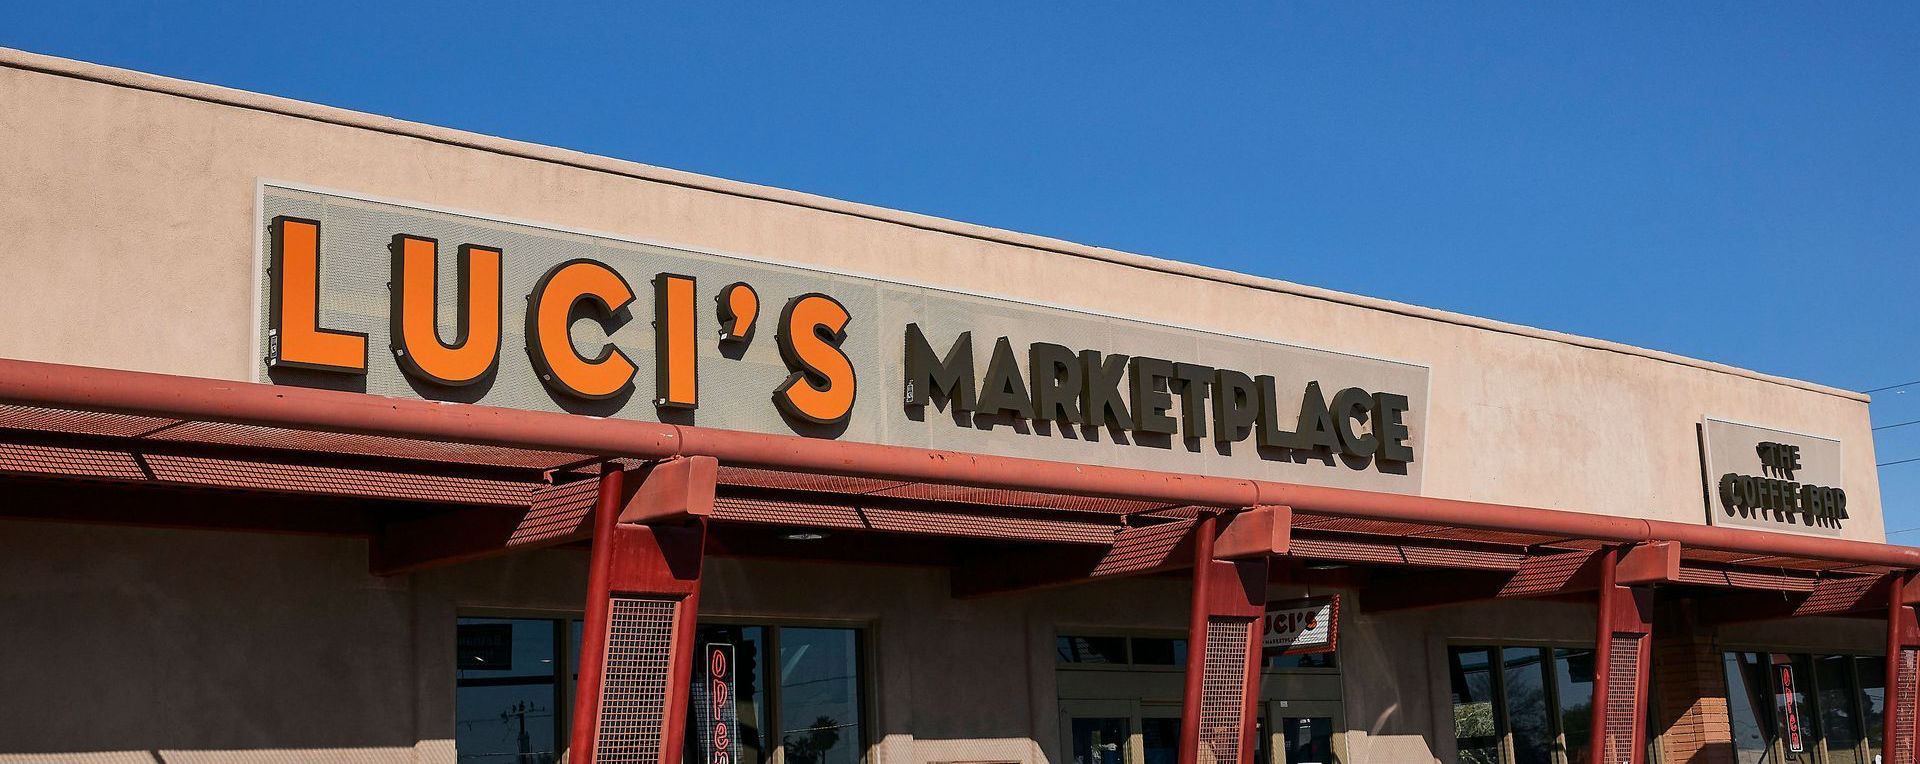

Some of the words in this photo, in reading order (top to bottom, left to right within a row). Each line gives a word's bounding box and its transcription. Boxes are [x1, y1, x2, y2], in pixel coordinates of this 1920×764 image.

[271, 215, 857, 425] LUCI'S
[905, 322, 1414, 464] MARKETPLACE
[1757, 441, 1801, 471] THE
[1719, 473, 1803, 515] COFFEE
[1801, 484, 1849, 520] BAR
[1264, 611, 1318, 635] UCI'S
